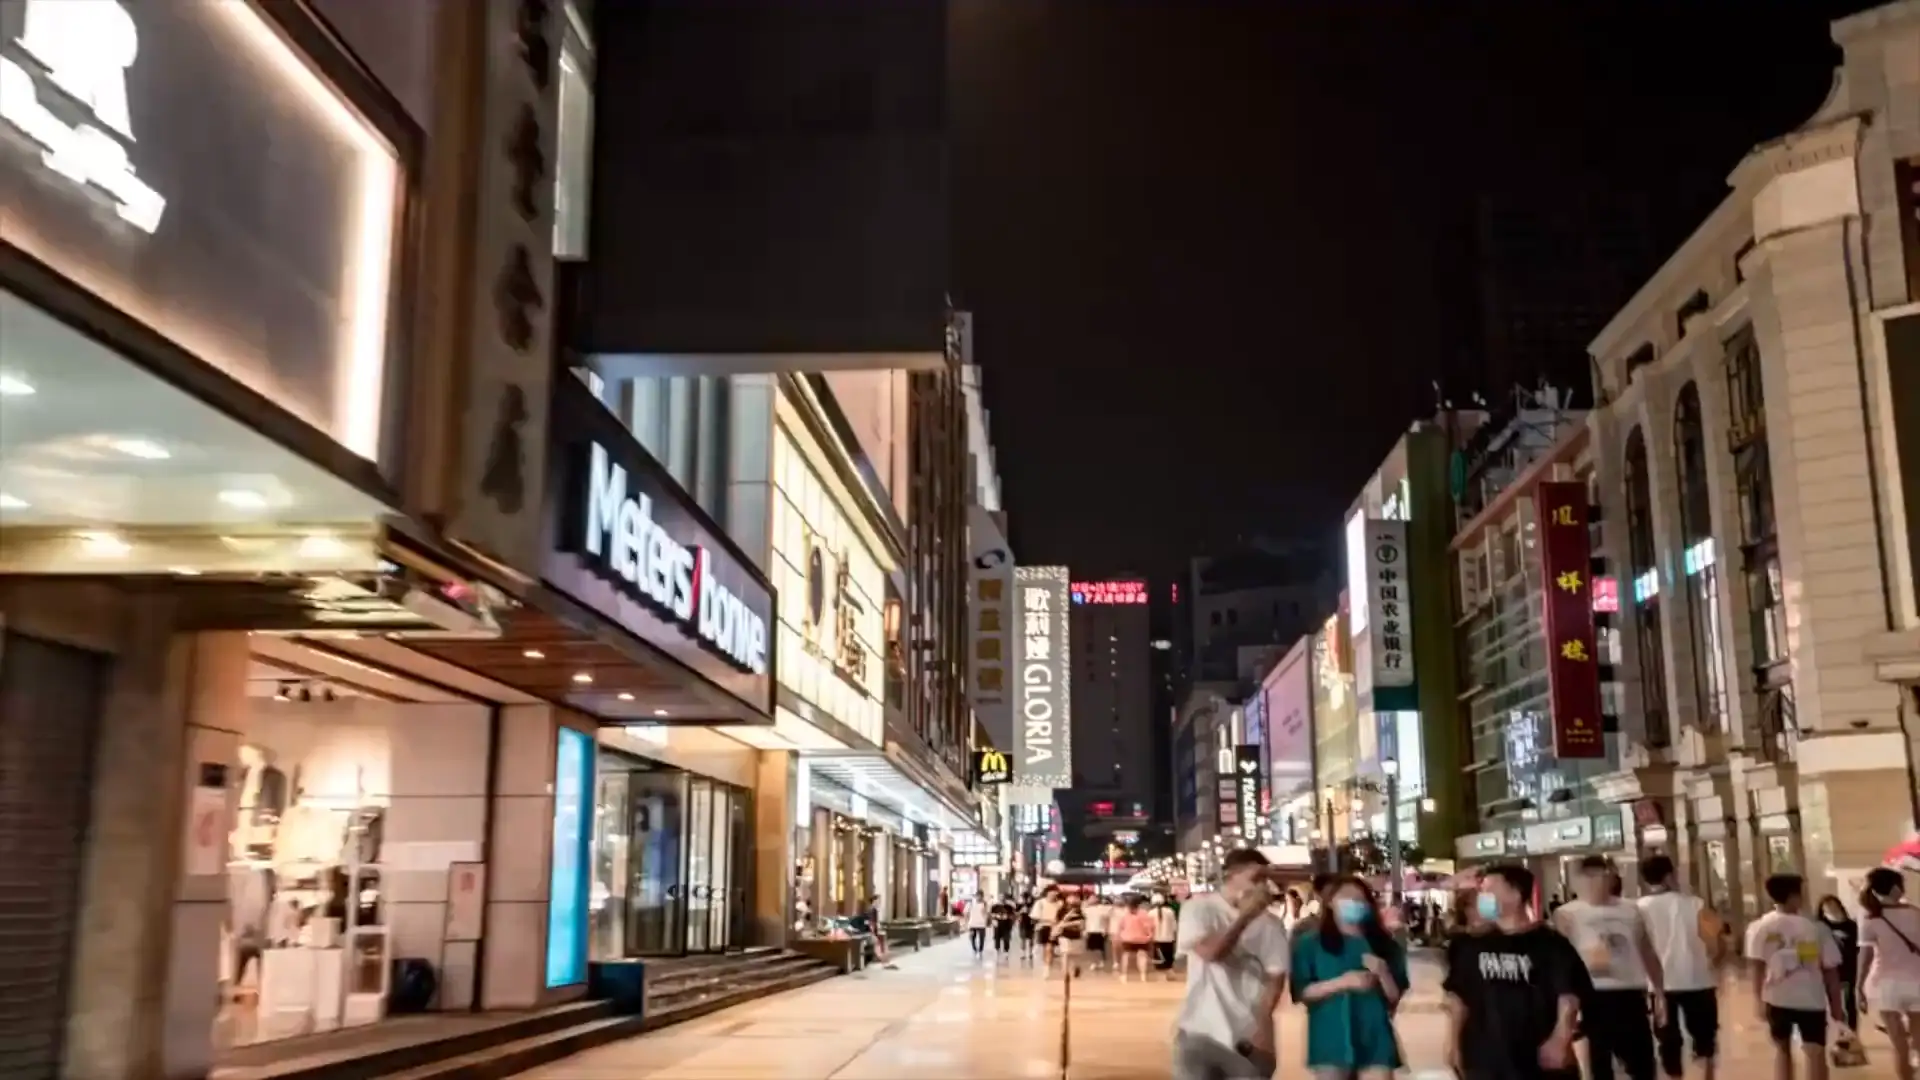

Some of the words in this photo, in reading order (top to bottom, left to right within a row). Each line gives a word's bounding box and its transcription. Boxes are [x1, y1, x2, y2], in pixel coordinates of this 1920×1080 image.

[1378, 568, 1403, 669] 中国农业银行
[1024, 664, 1053, 764] GLORIA
[1478, 951, 1532, 984] PARTY
